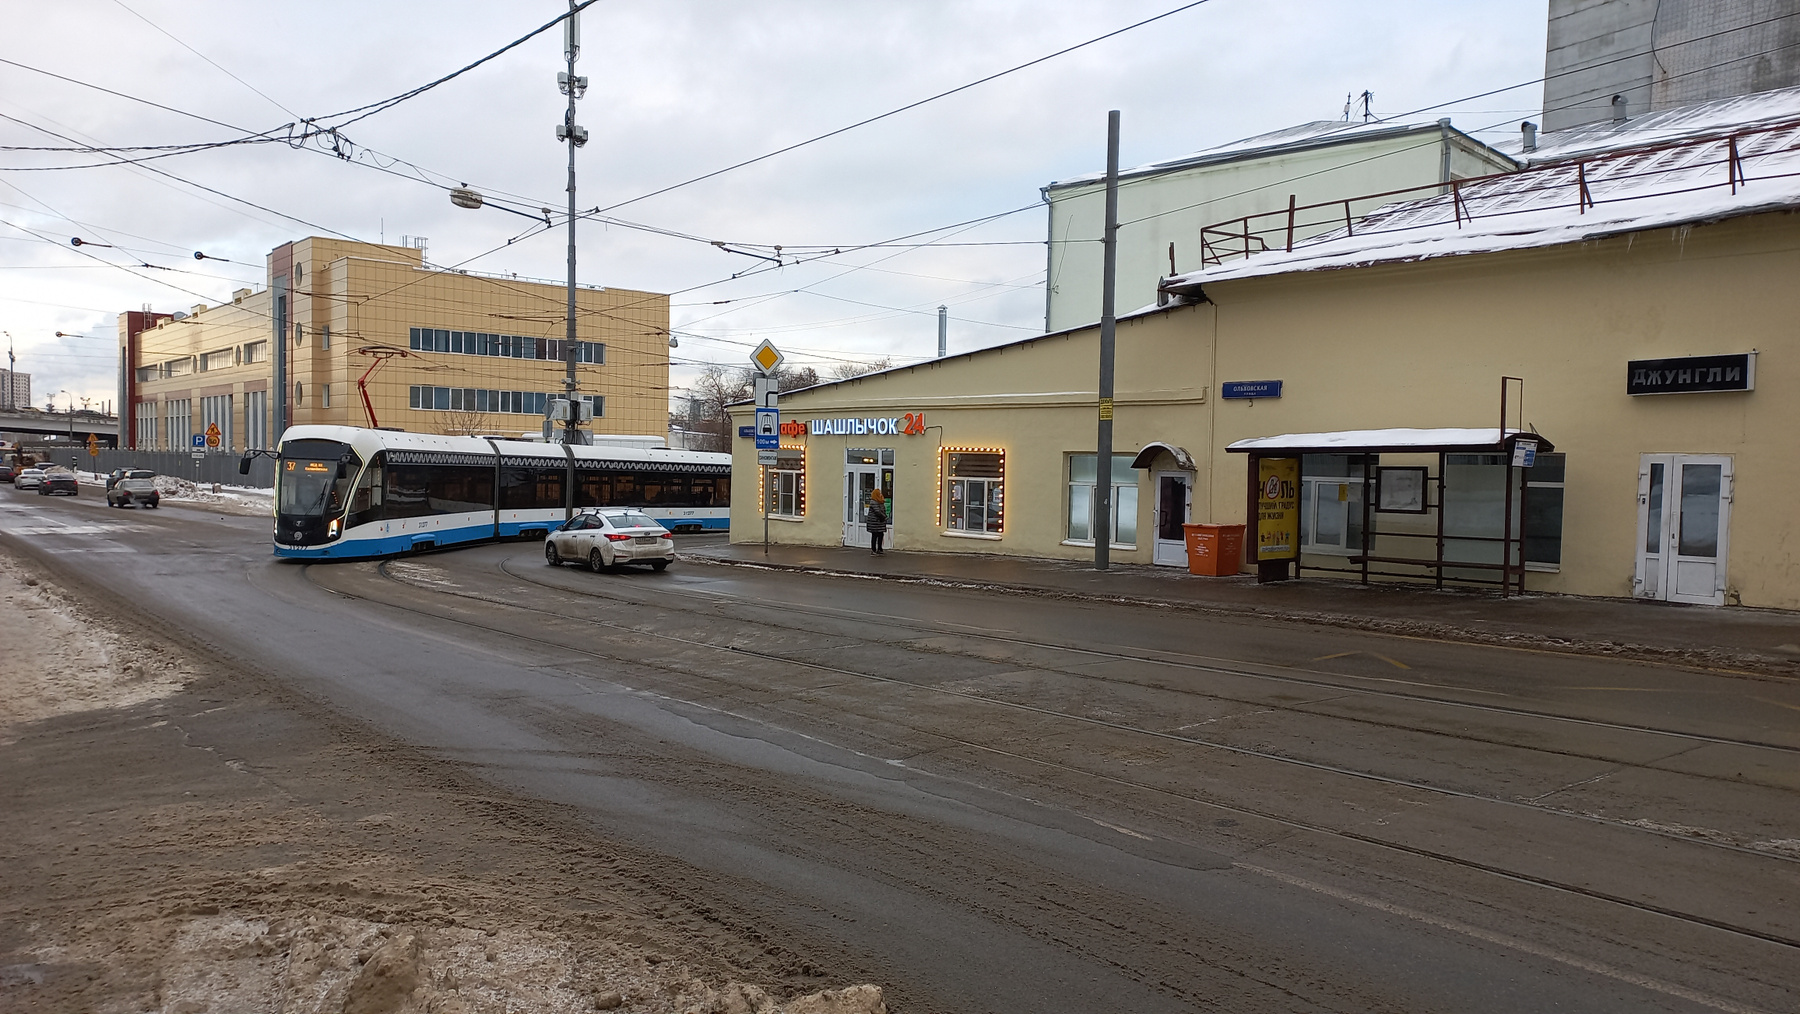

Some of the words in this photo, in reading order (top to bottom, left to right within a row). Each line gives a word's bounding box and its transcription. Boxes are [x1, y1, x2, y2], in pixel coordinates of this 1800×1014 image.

[1632, 366, 1741, 386] ДЖУНГЛИ
[779, 419, 806, 438] афе
[811, 418, 899, 435] ШАШЛЫЧОК
[903, 412, 926, 435] 24
[286, 461, 296, 471] 37
